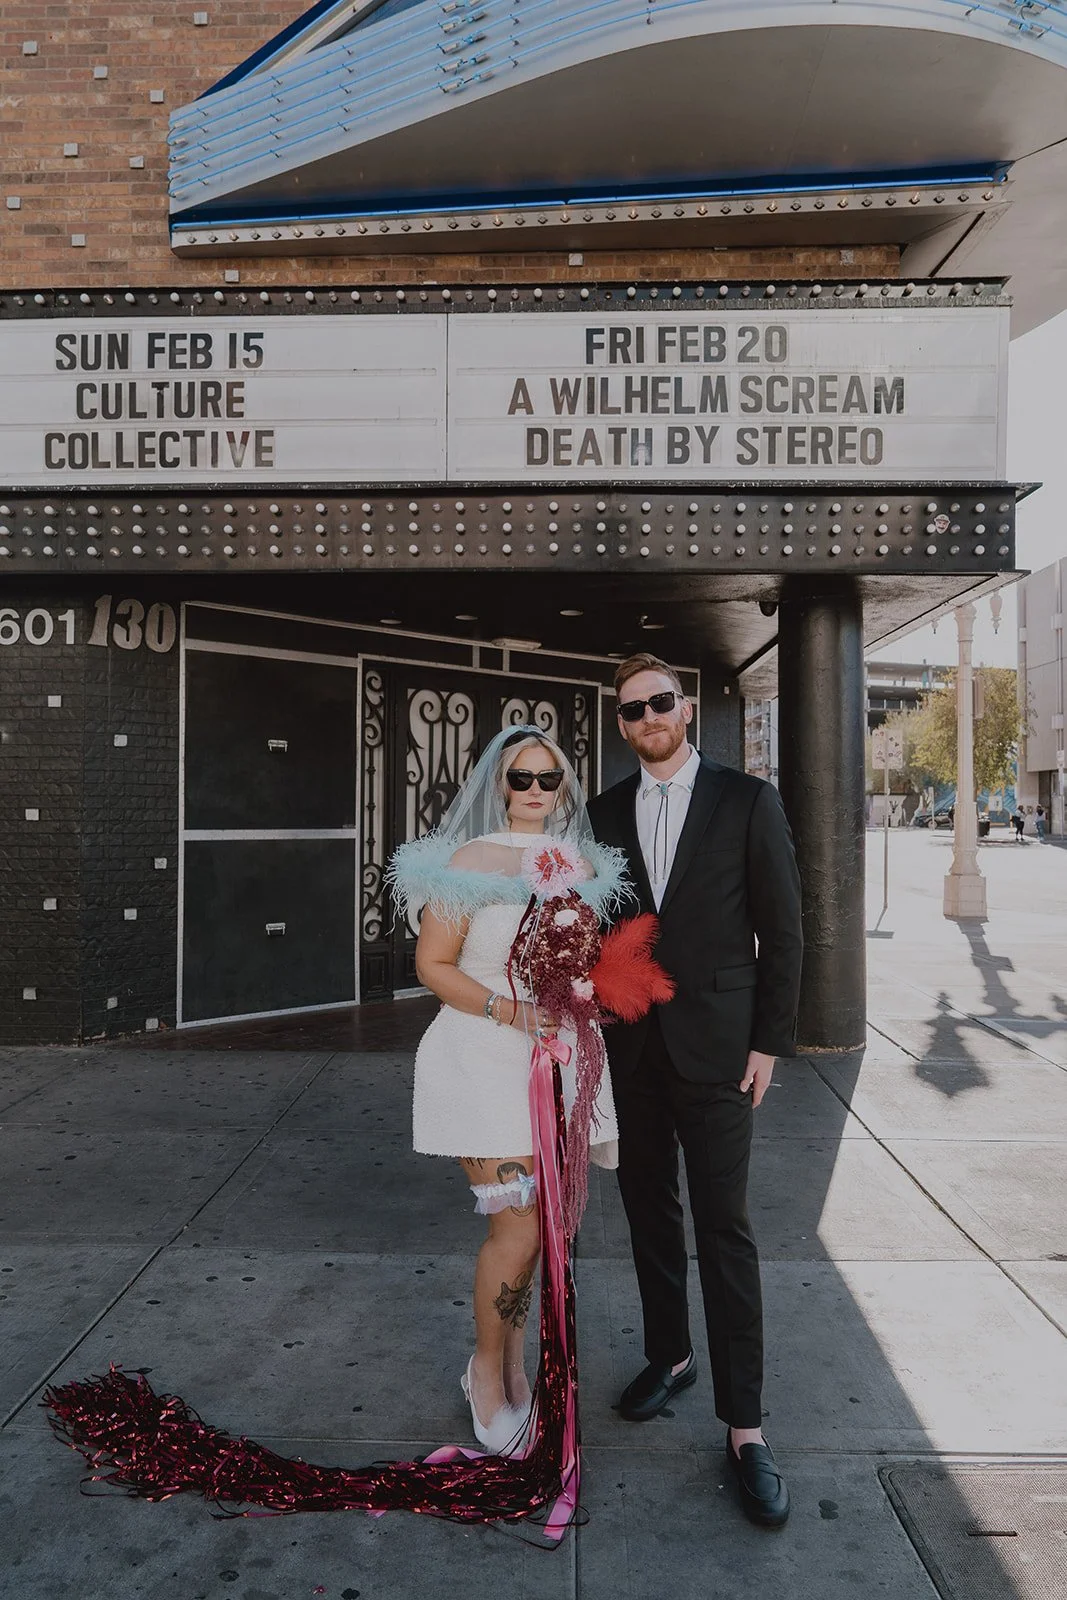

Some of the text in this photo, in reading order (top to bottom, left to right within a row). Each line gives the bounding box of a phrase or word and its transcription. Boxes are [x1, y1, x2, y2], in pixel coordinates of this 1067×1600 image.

[55, 332, 264, 371] SUN FEB 15
[585, 325, 787, 365] FRI FEB 20
[76, 381, 245, 420] CULTURE
[507, 375, 905, 415] A WILHELM SCREAM
[44, 430, 275, 470] COLLECTIVE
[526, 425, 883, 466] DEATH BY STEREO
[0, 608, 75, 646] 601
[87, 594, 177, 653] 130
